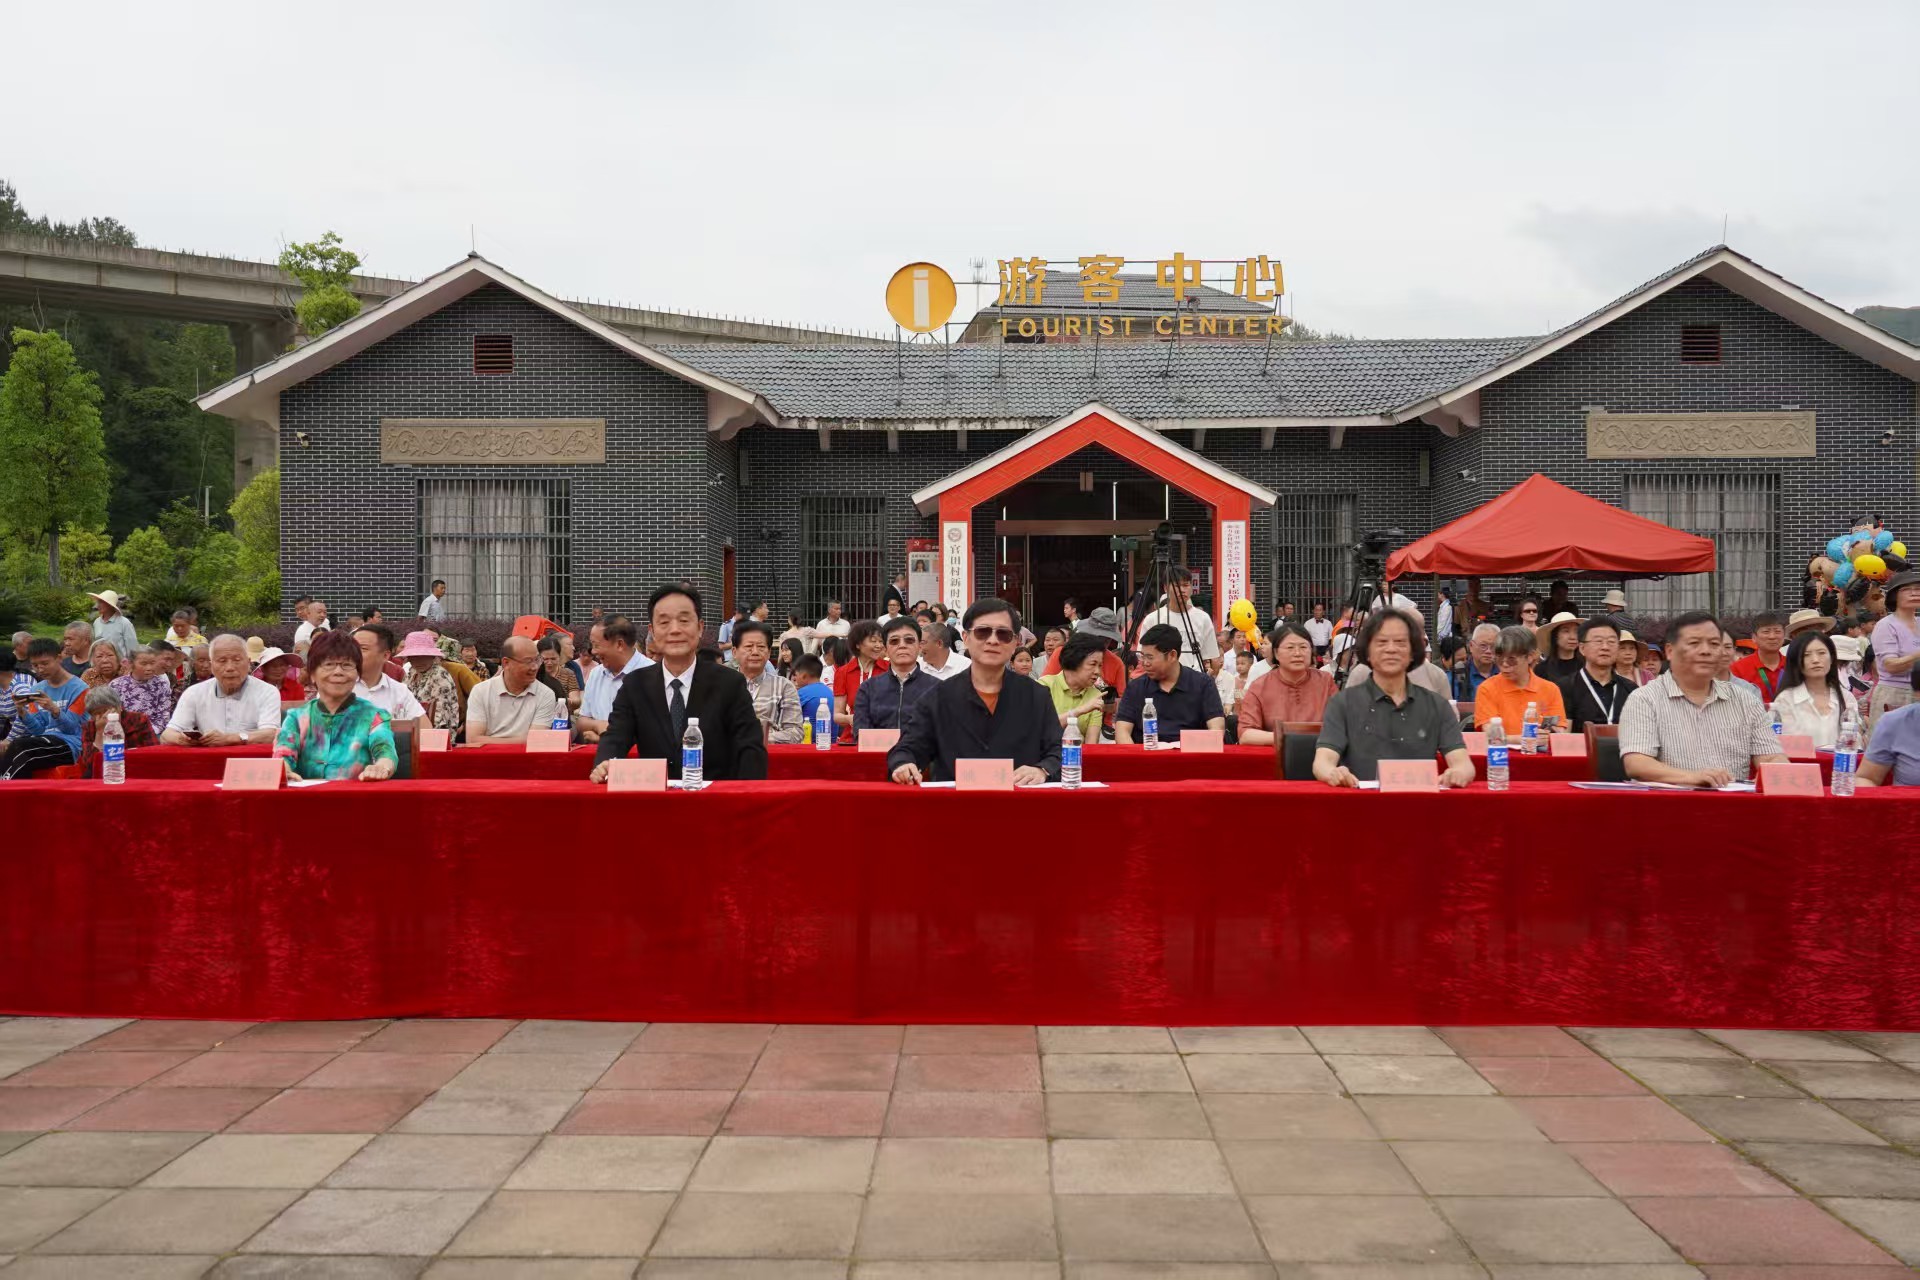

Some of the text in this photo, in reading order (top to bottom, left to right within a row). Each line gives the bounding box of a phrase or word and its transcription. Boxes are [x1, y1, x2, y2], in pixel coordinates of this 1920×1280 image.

[997, 252, 1285, 306] 游客中心
[997, 315, 1284, 338] TOURIST CENTER
